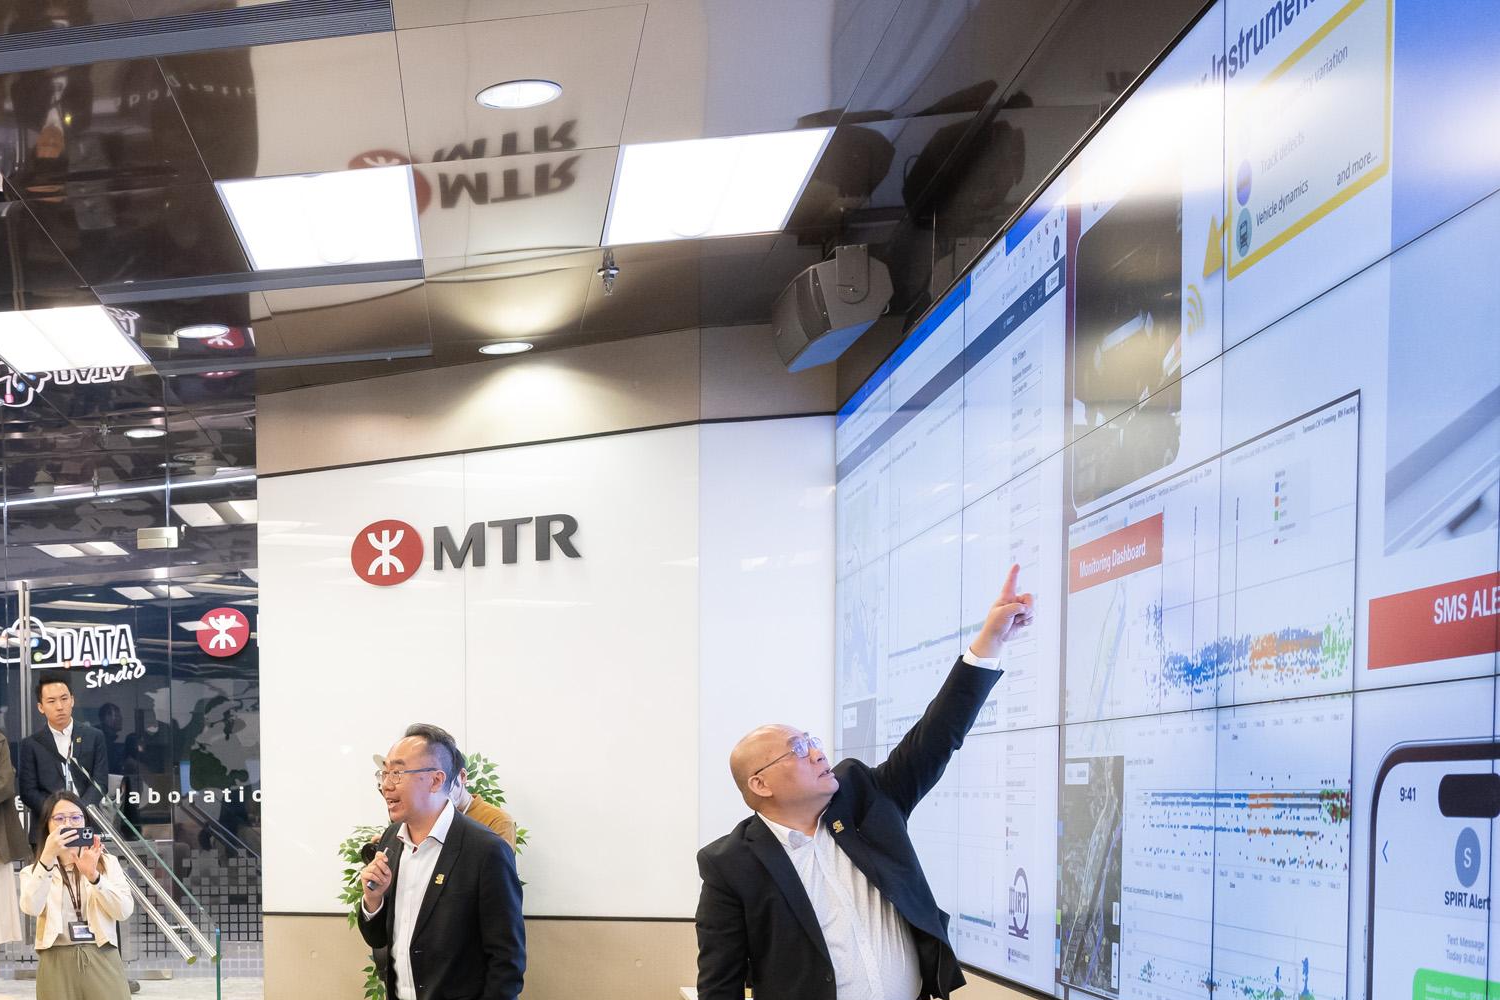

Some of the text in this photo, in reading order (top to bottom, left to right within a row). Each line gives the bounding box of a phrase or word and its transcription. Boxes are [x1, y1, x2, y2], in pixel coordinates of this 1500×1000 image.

[1212, 0, 1315, 84] Instrumen
[1336, 167, 1351, 187] and
[1256, 179, 1309, 228] Vehicle dynamics
[433, 513, 582, 571] MTR
[1079, 538, 1146, 578] Monitoring Dashboard
[1434, 593, 1467, 625] SMS
[58, 625, 135, 662] DATA
[85, 660, 146, 689] Studio
[1400, 787, 1417, 802] 9:41
[1463, 847, 1472, 869] S
[1444, 890, 1490, 910] SPIRT Alert
[1446, 949, 1462, 964] Today
[1447, 934, 1485, 951] Text Message
